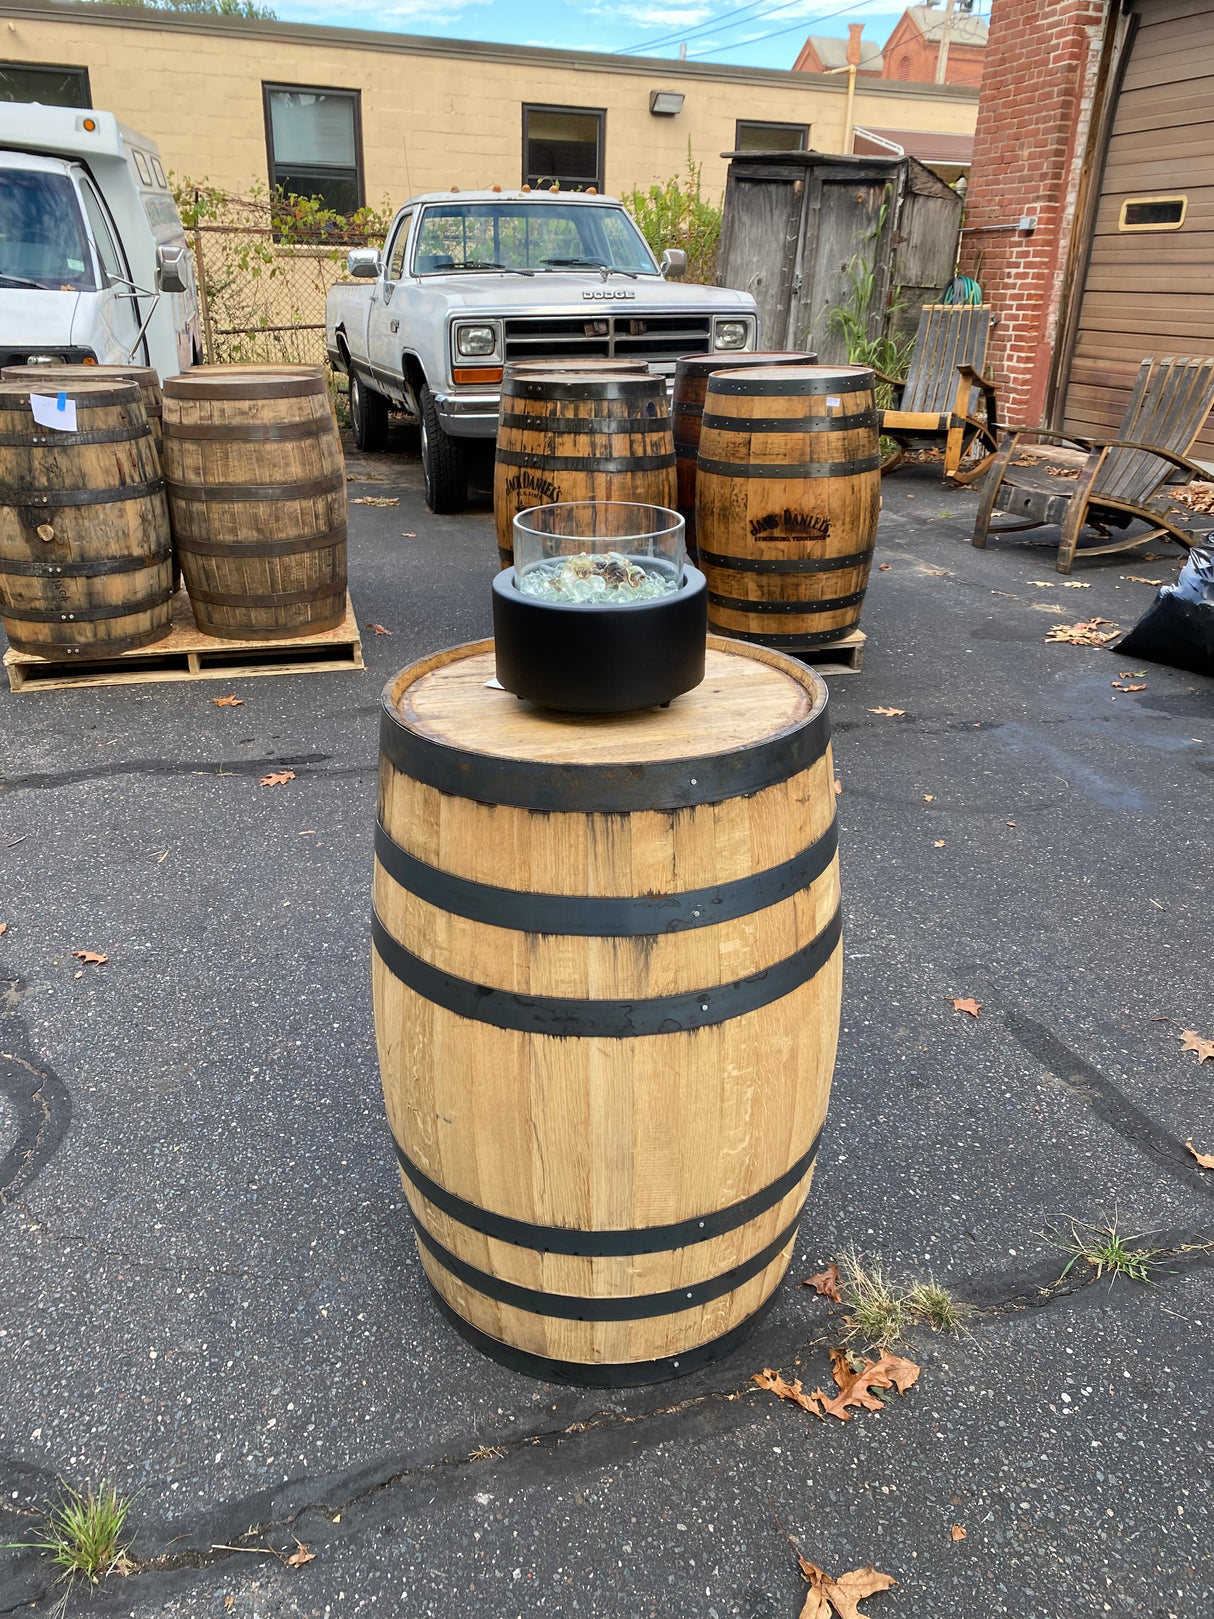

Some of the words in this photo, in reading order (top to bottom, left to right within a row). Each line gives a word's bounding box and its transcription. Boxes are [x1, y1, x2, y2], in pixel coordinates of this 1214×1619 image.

[582, 291, 635, 299] DODGE
[523, 471, 563, 503] DANIEL'S
[783, 509, 832, 535] DANIEL'S
